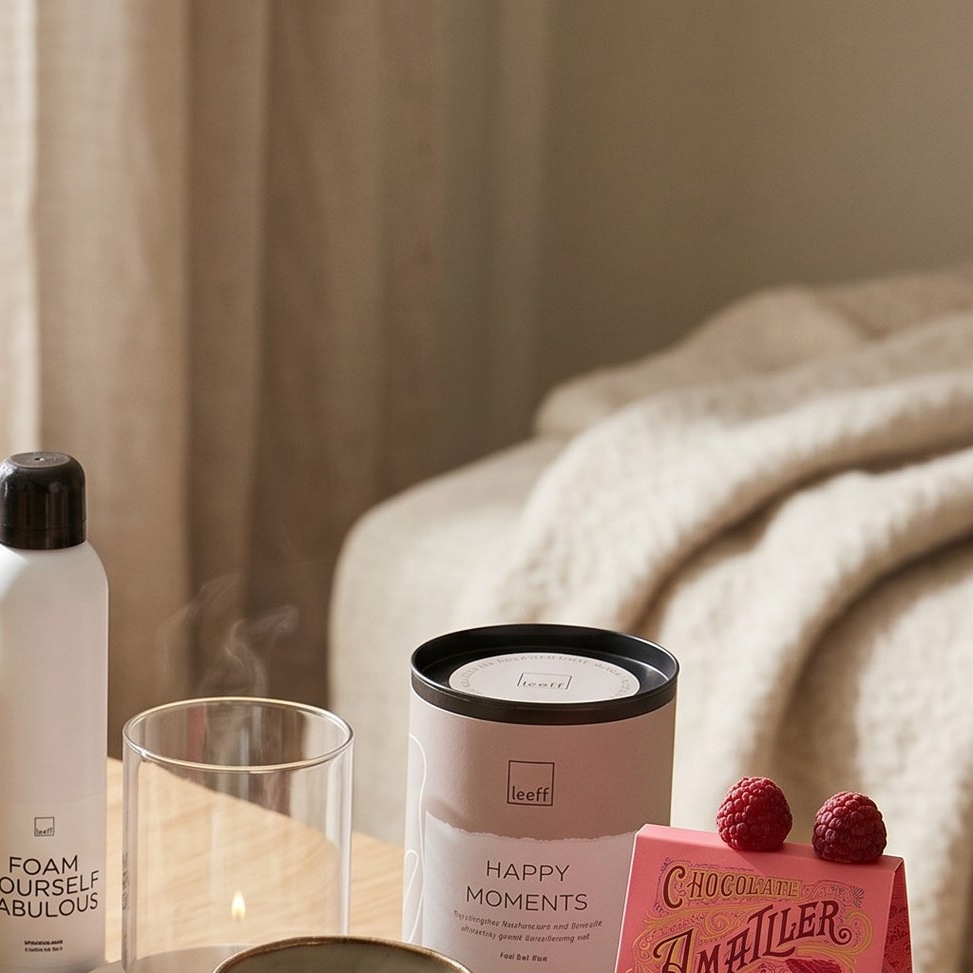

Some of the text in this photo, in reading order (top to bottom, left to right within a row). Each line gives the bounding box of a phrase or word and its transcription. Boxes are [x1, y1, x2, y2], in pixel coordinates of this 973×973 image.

[512, 785, 550, 802] leeff
[9, 854, 78, 876] FOAM
[486, 860, 570, 882] HAPPY
[662, 865, 801, 909] CHOCOLATE
[466, 885, 588, 912] MOMENTS
